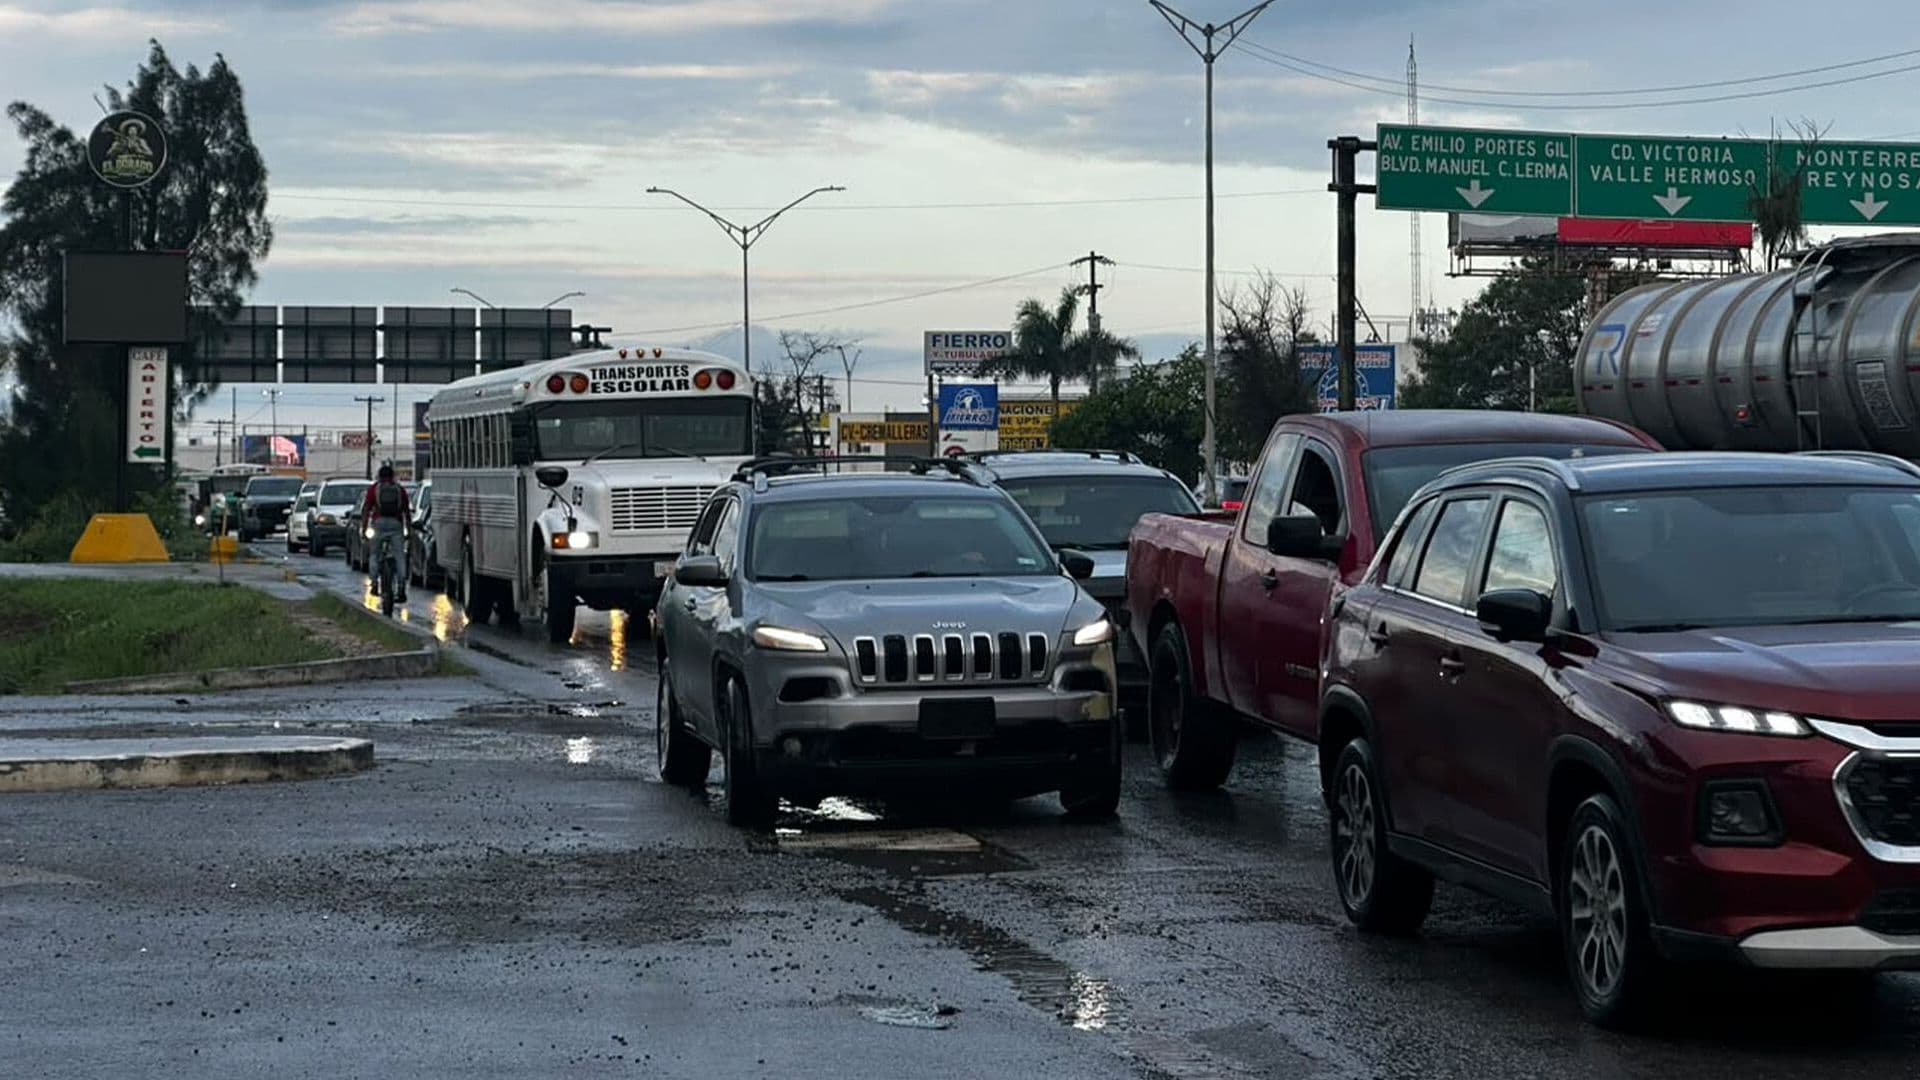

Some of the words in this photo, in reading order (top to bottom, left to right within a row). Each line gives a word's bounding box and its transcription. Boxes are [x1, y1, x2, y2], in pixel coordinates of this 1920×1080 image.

[1382, 133, 1403, 151] AV.
[1411, 135, 1465, 154] EMILIO
[1475, 138, 1536, 157] PORTES
[1544, 141, 1569, 158] GIL
[1611, 144, 1635, 161] CD.
[1641, 145, 1734, 164] VICTORIA
[1381, 155, 1422, 173] BLVD.
[1426, 157, 1490, 176] MANUEL
[1498, 161, 1512, 177] C.
[1515, 163, 1569, 180] LERMA
[1590, 165, 1654, 183] VALLE
[1664, 167, 1756, 187] HERMOSO
[932, 334, 1006, 349] FIERRO
[590, 365, 689, 381] TRANSPORTES
[590, 379, 690, 394] ESCOLAR
[140, 363, 156, 443] ABIERTO
[932, 621, 966, 629] Jeep
